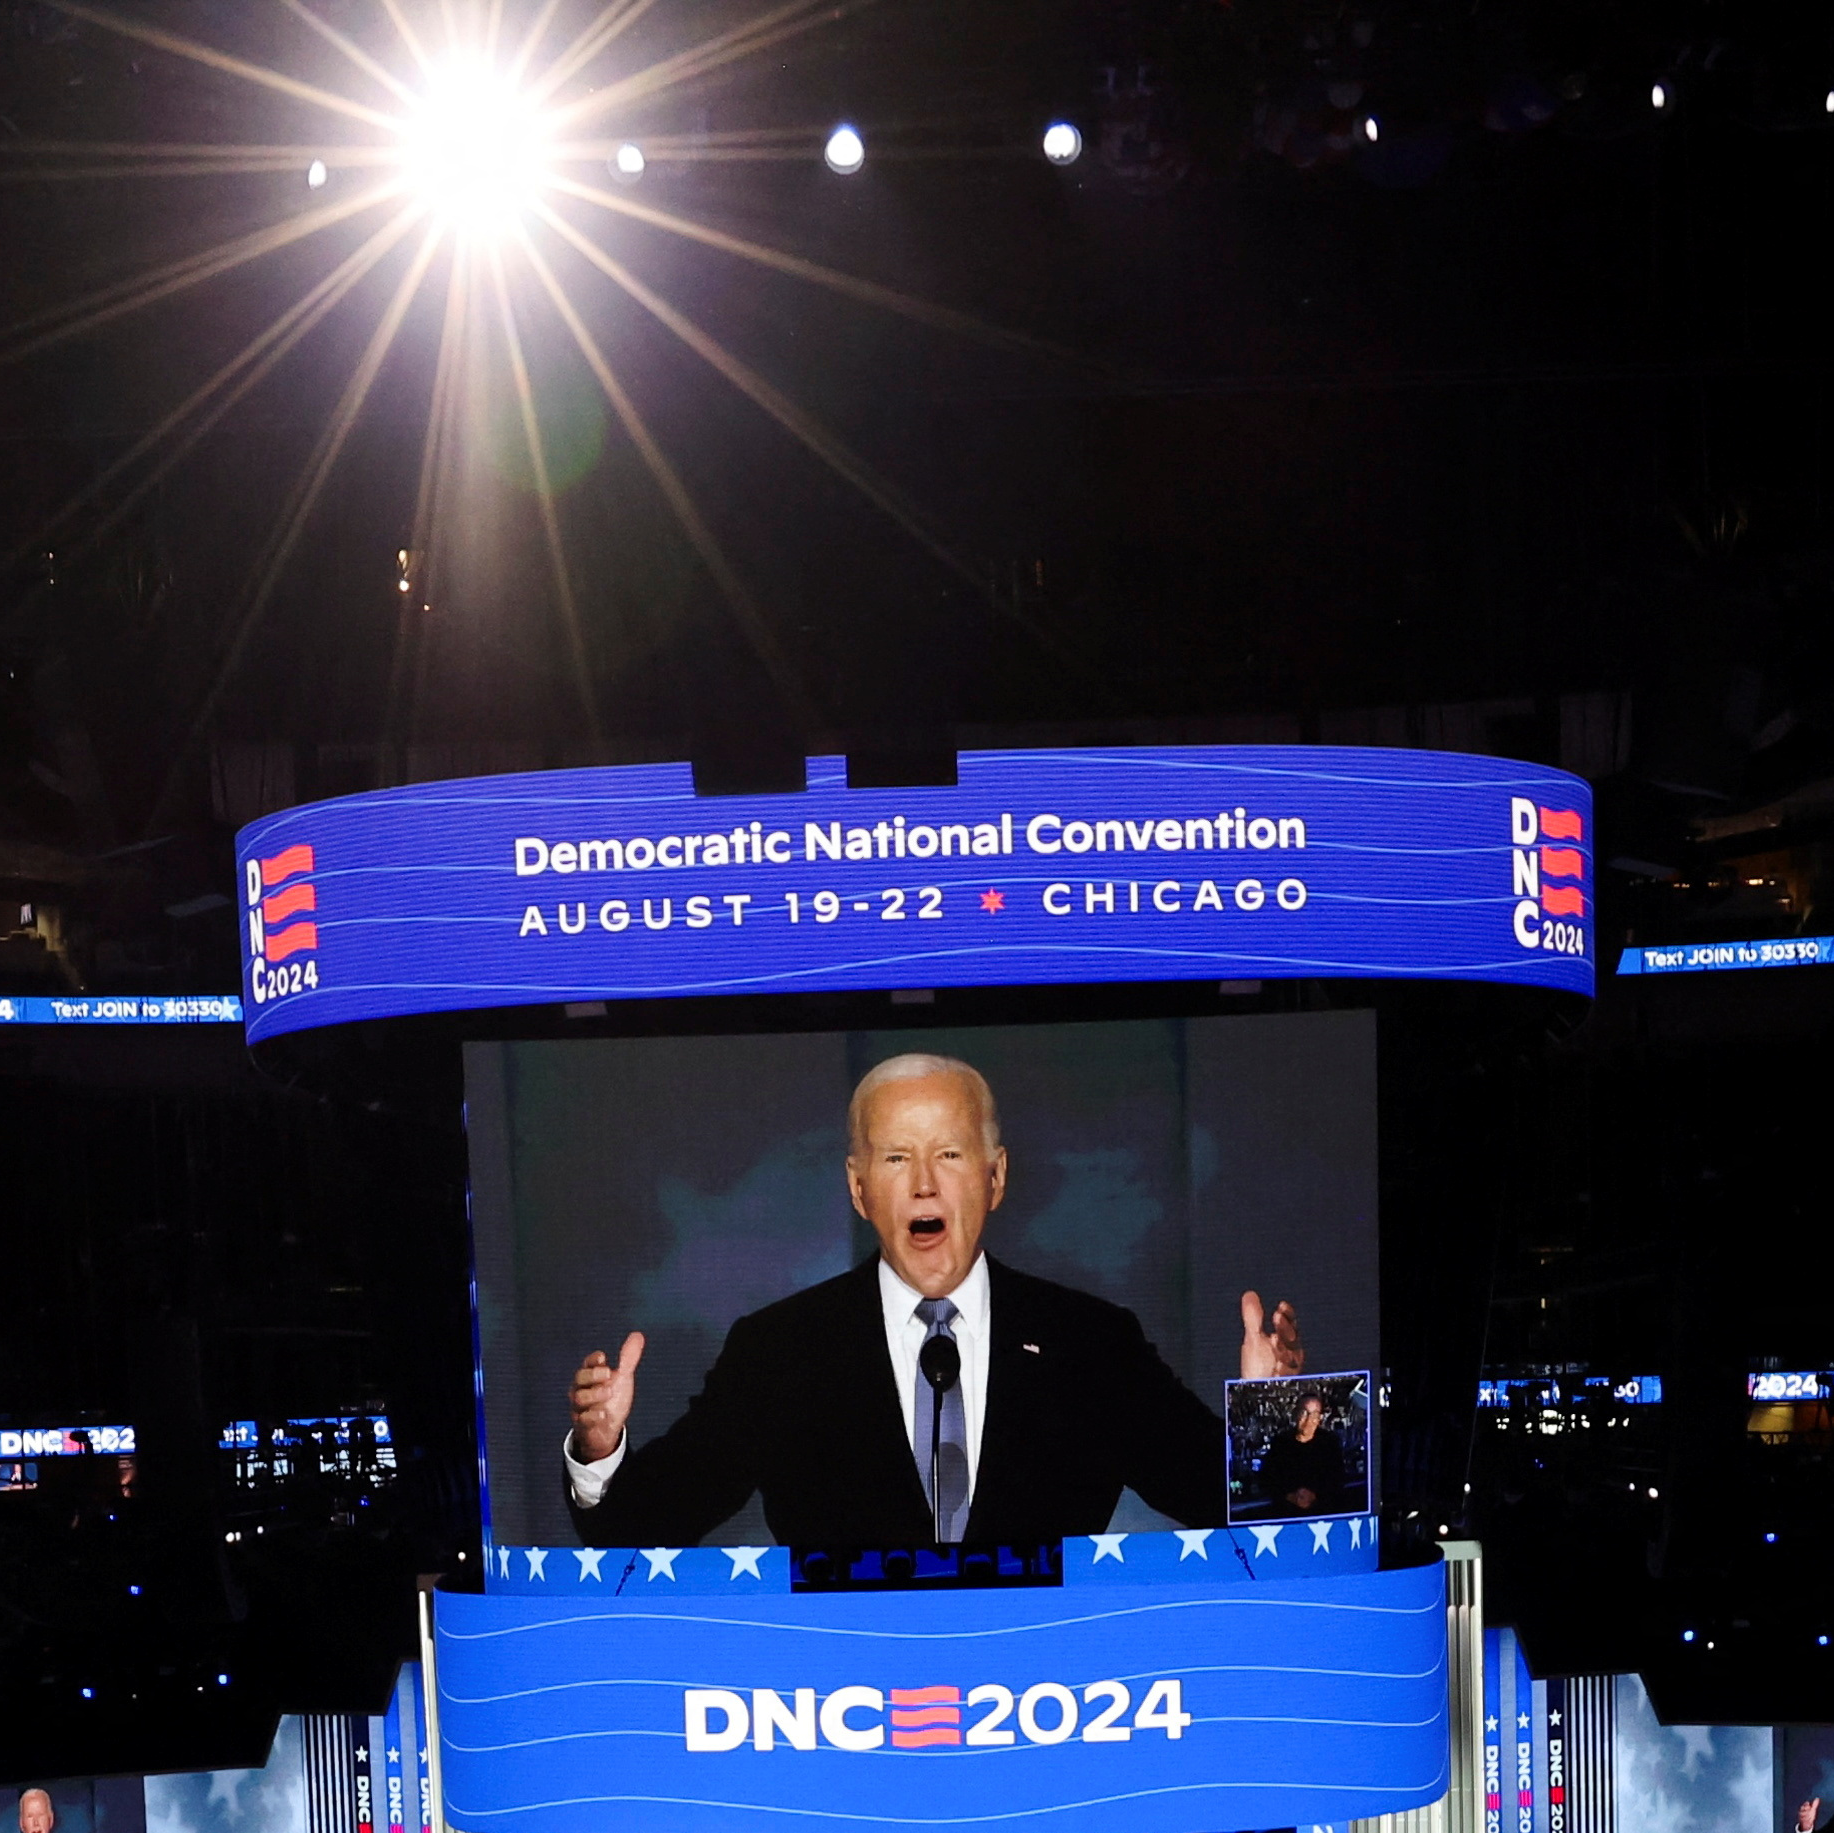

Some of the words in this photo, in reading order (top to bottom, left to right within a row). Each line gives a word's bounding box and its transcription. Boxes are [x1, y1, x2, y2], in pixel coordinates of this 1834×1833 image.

[515, 822, 791, 875] Democratic
[804, 814, 1012, 861] National
[1027, 808, 1305, 853] Convention
[516, 895, 750, 936] AUGUST
[780, 887, 942, 923] 19-22
[1039, 878, 1306, 914] CHICAGO
[1542, 921, 1585, 957] 2024
[1645, 952, 1683, 967] Text
[1688, 948, 1733, 965] JOIN
[1739, 948, 1757, 962] to
[266, 959, 318, 999] 2024
